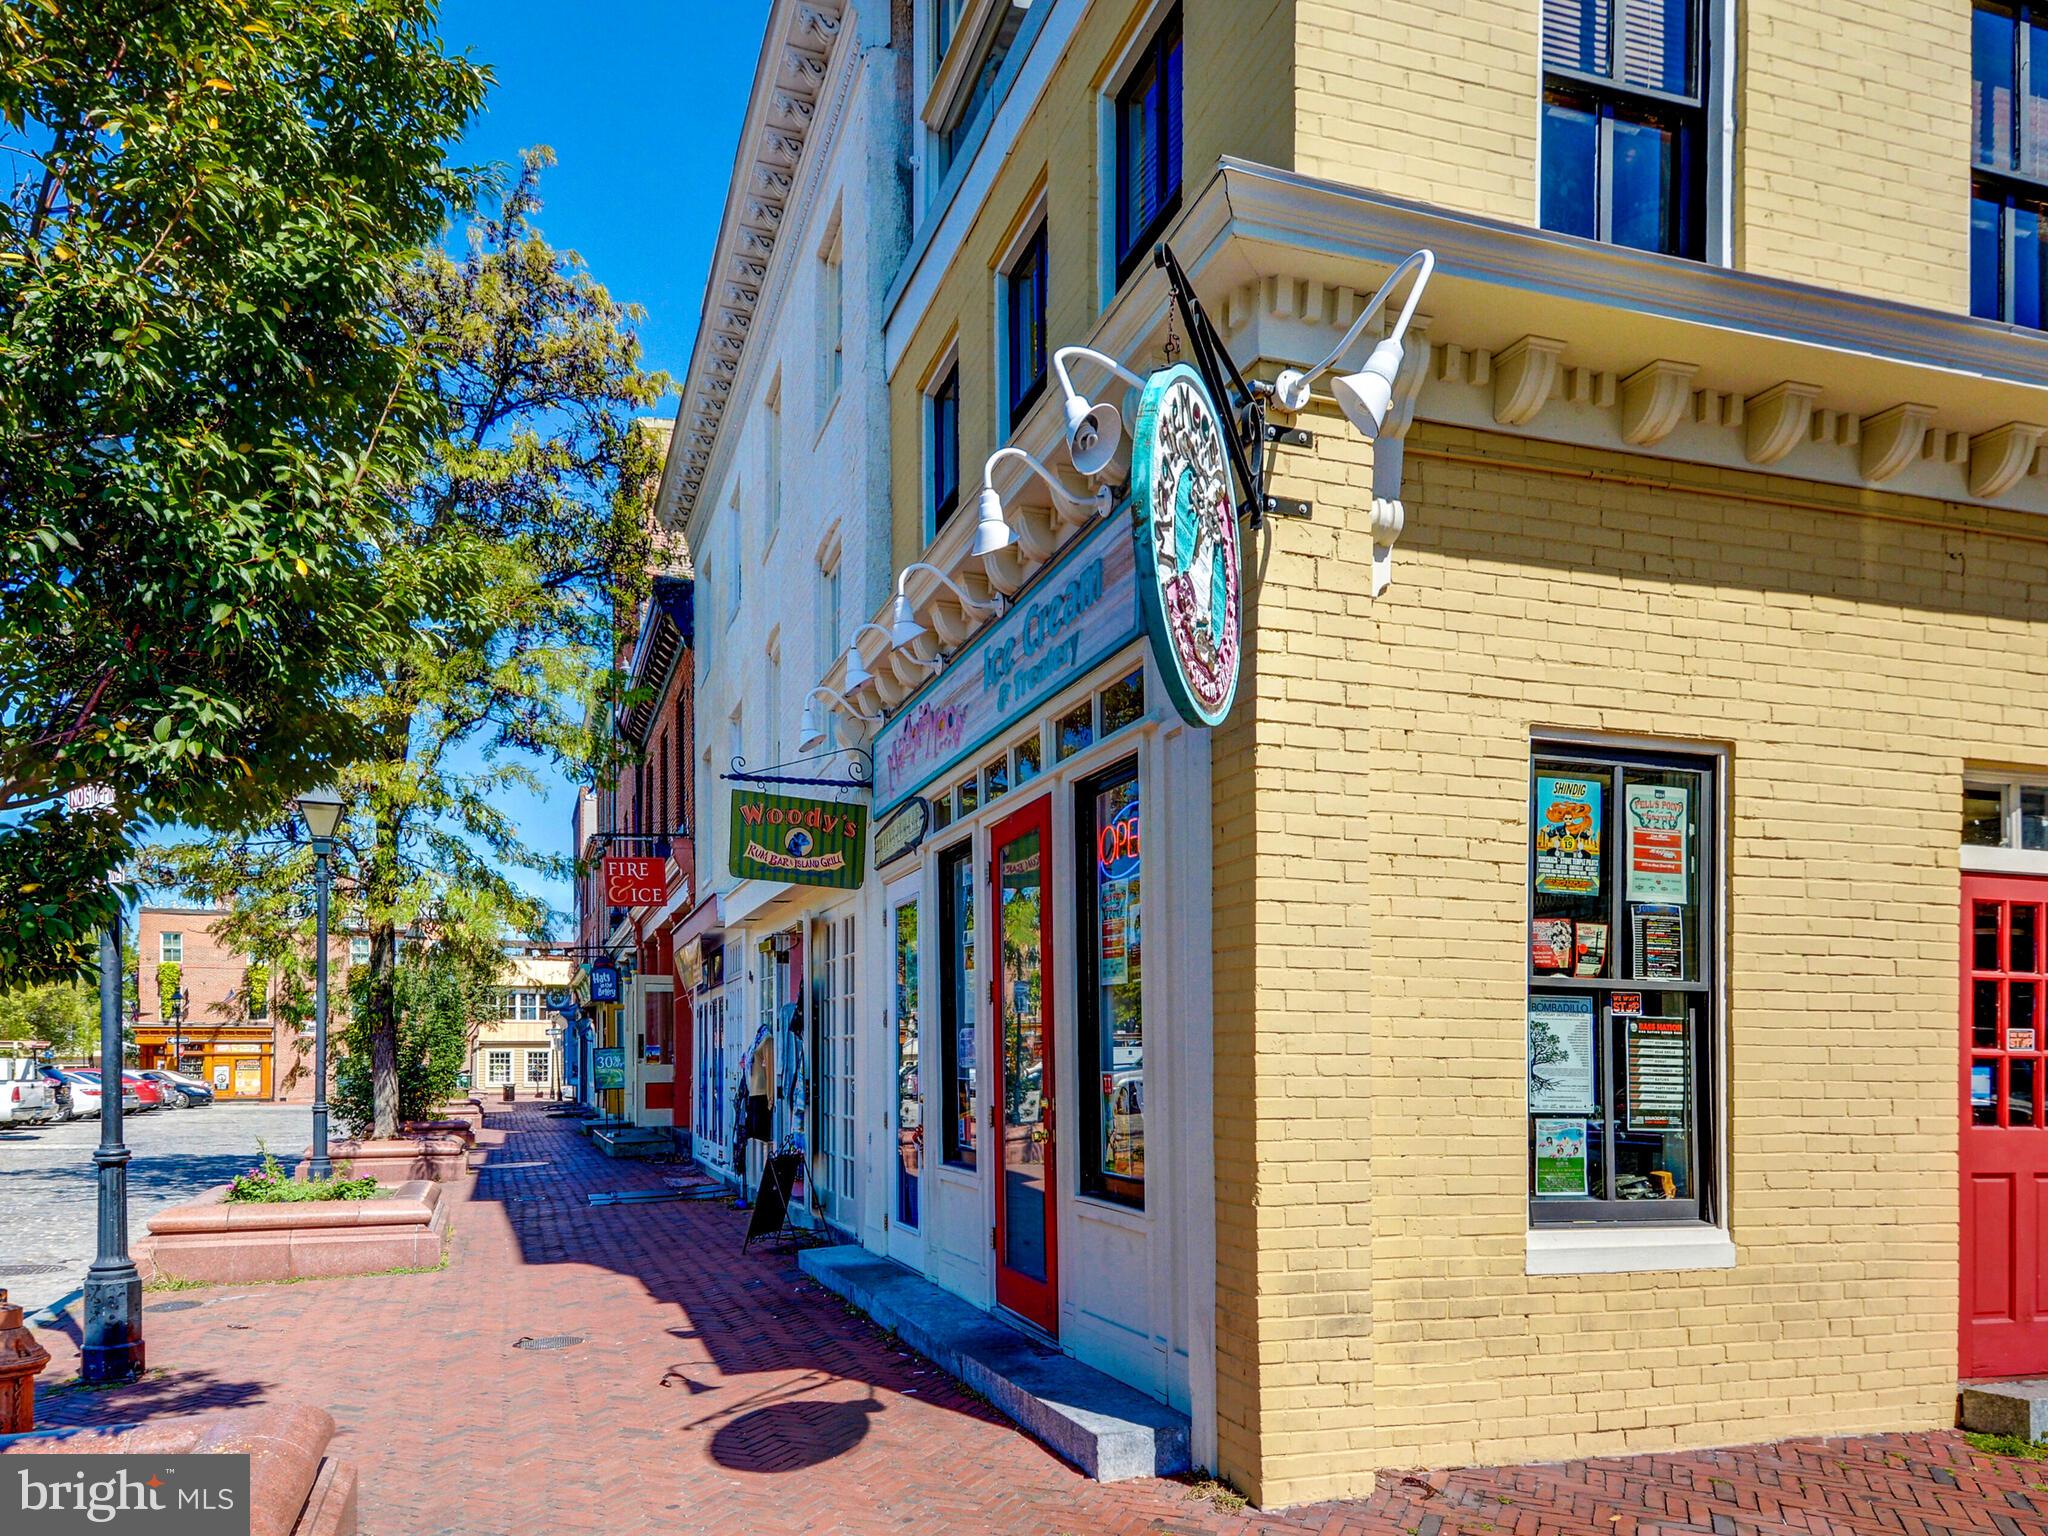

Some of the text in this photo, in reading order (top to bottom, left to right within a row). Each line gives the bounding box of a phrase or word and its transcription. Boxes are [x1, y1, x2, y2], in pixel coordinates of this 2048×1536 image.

[983, 558, 1103, 693] Ice Cream
[1014, 630, 1082, 702] Treatery
[70, 786, 84, 808] NO
[1554, 782, 1587, 796] SHINDIG
[740, 802, 858, 839] Woody's
[1100, 818, 1140, 866] OPE
[747, 844, 768, 862] RUM
[769, 854, 789, 867] BAR
[794, 857, 820, 868] ISLAND
[820, 854, 842, 867] GRILL
[608, 861, 649, 880] FIRE
[609, 875, 662, 902] & ICE
[592, 972, 611, 984] Hats
[1531, 1002, 1589, 1014] BOMBADILLO
